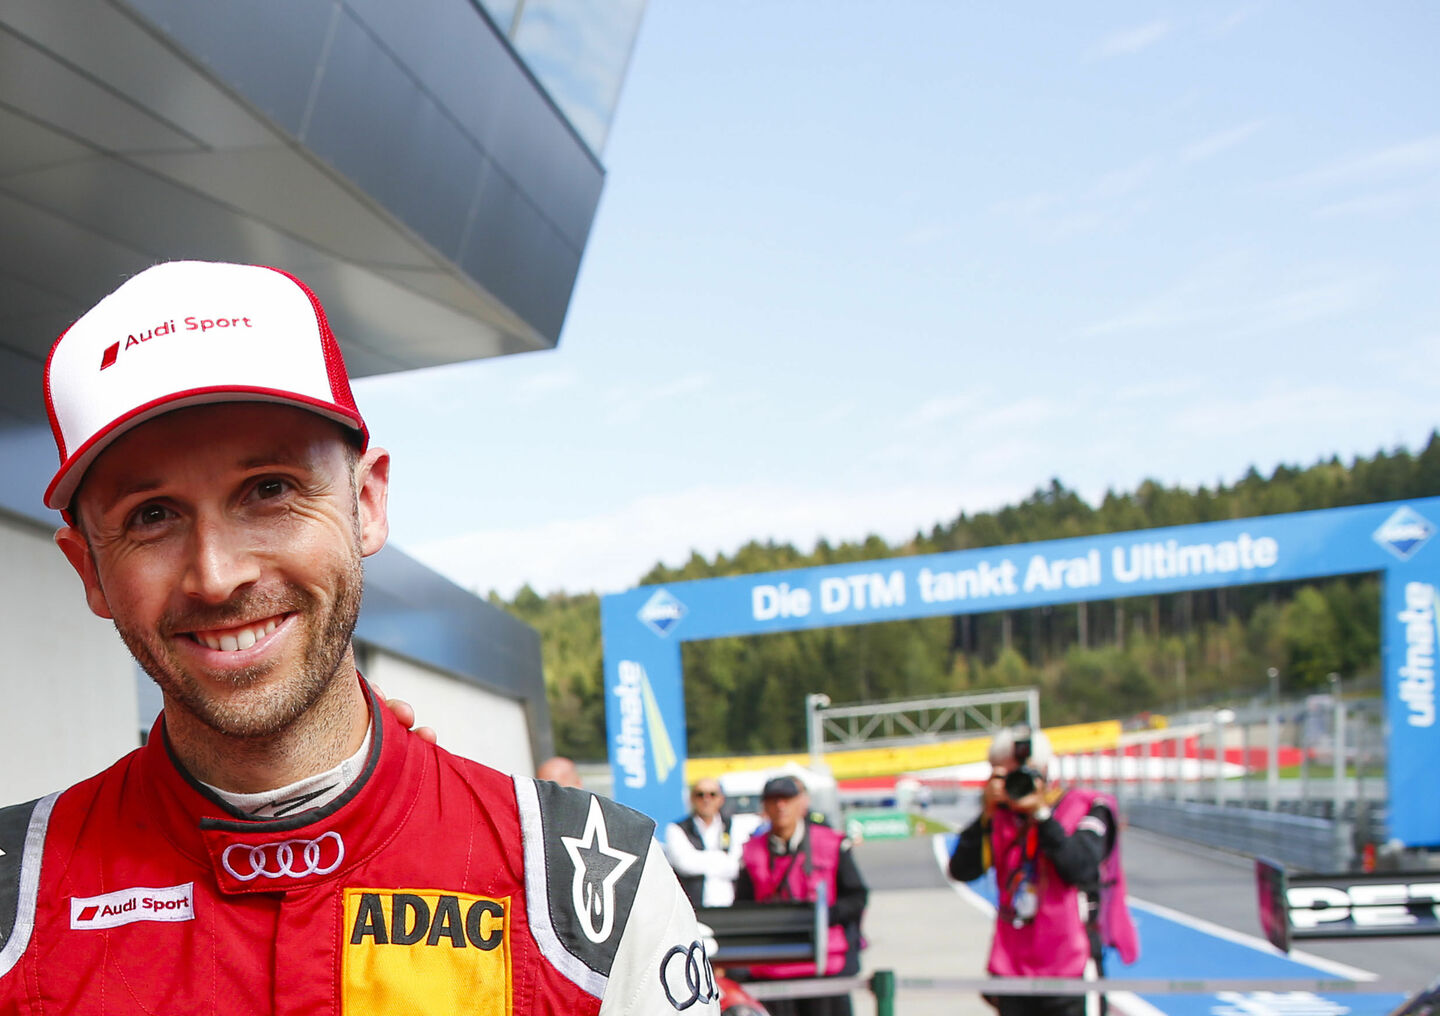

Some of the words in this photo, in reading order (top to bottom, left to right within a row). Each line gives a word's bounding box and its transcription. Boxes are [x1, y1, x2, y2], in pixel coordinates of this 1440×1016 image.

[125, 319, 176, 351] Audi
[184, 316, 253, 333] Sport
[751, 582, 812, 621] Die
[820, 570, 906, 615] DTM
[917, 557, 1018, 603] tankt
[1023, 548, 1102, 593] Aral
[1111, 532, 1279, 584] Ultimate
[1397, 580, 1437, 728] ultimate
[613, 659, 647, 789] ultimate
[101, 899, 138, 919] Audi
[141, 895, 190, 913] Sport
[350, 893, 504, 952] ADAC
